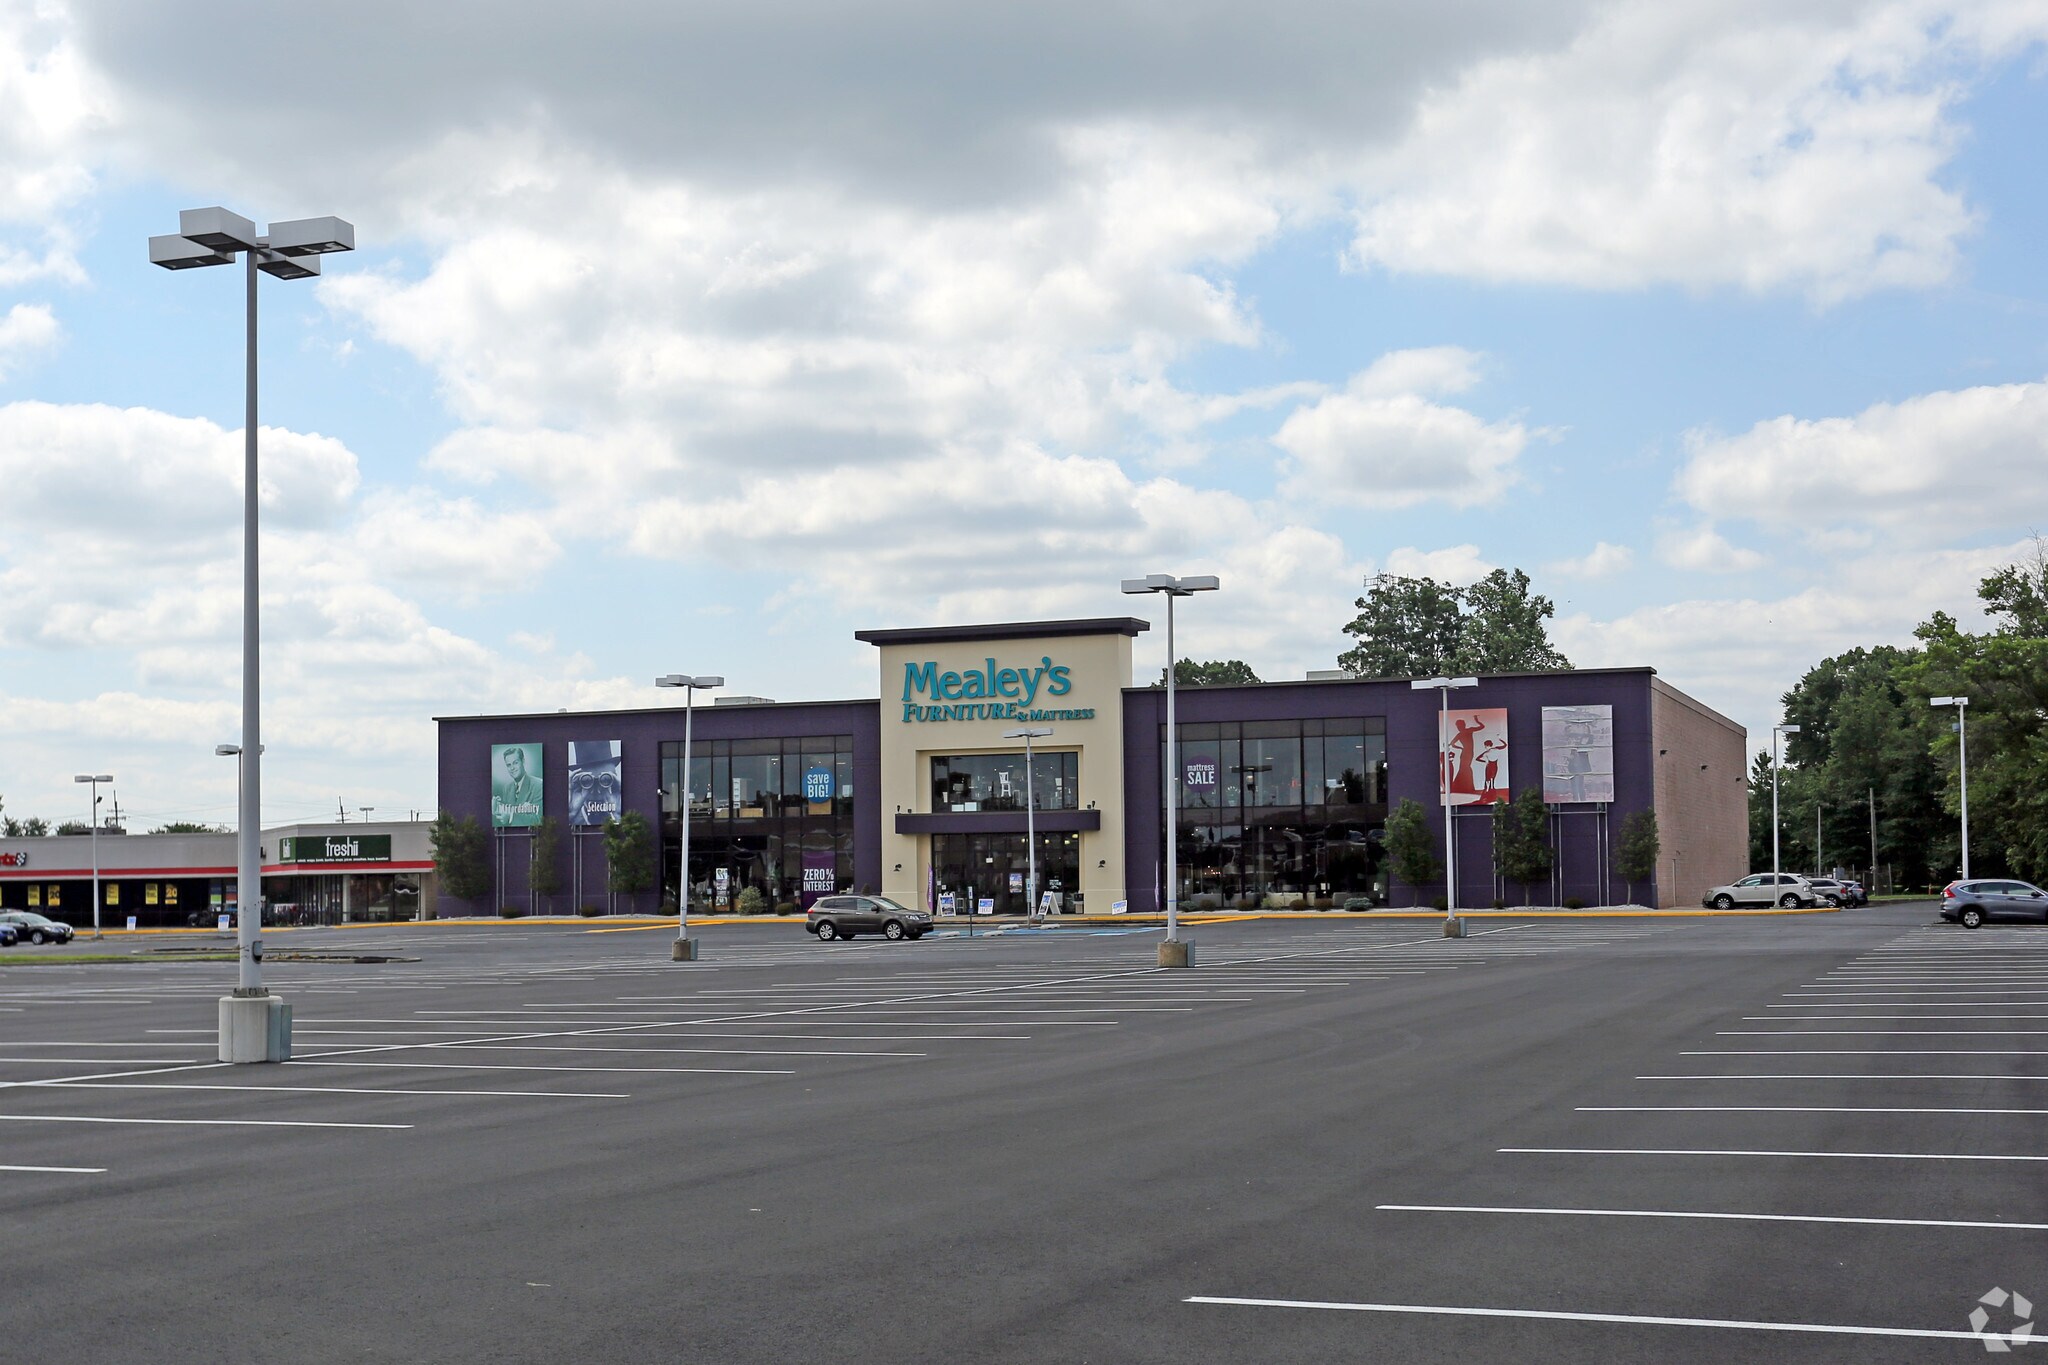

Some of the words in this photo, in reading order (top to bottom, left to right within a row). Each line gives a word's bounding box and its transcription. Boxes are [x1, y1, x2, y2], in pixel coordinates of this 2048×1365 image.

[901, 656, 1072, 707] Mealey's
[902, 702, 1018, 722] FURNITURE
[1017, 711, 1028, 722] &
[1030, 708, 1096, 722] MATTRESS
[1187, 764, 1215, 772] mattress
[807, 773, 829, 785] save
[1187, 771, 1215, 785] SALE
[807, 784, 829, 798] BIG!
[325, 837, 359, 857] freshii
[803, 881, 835, 892] INTEREST
